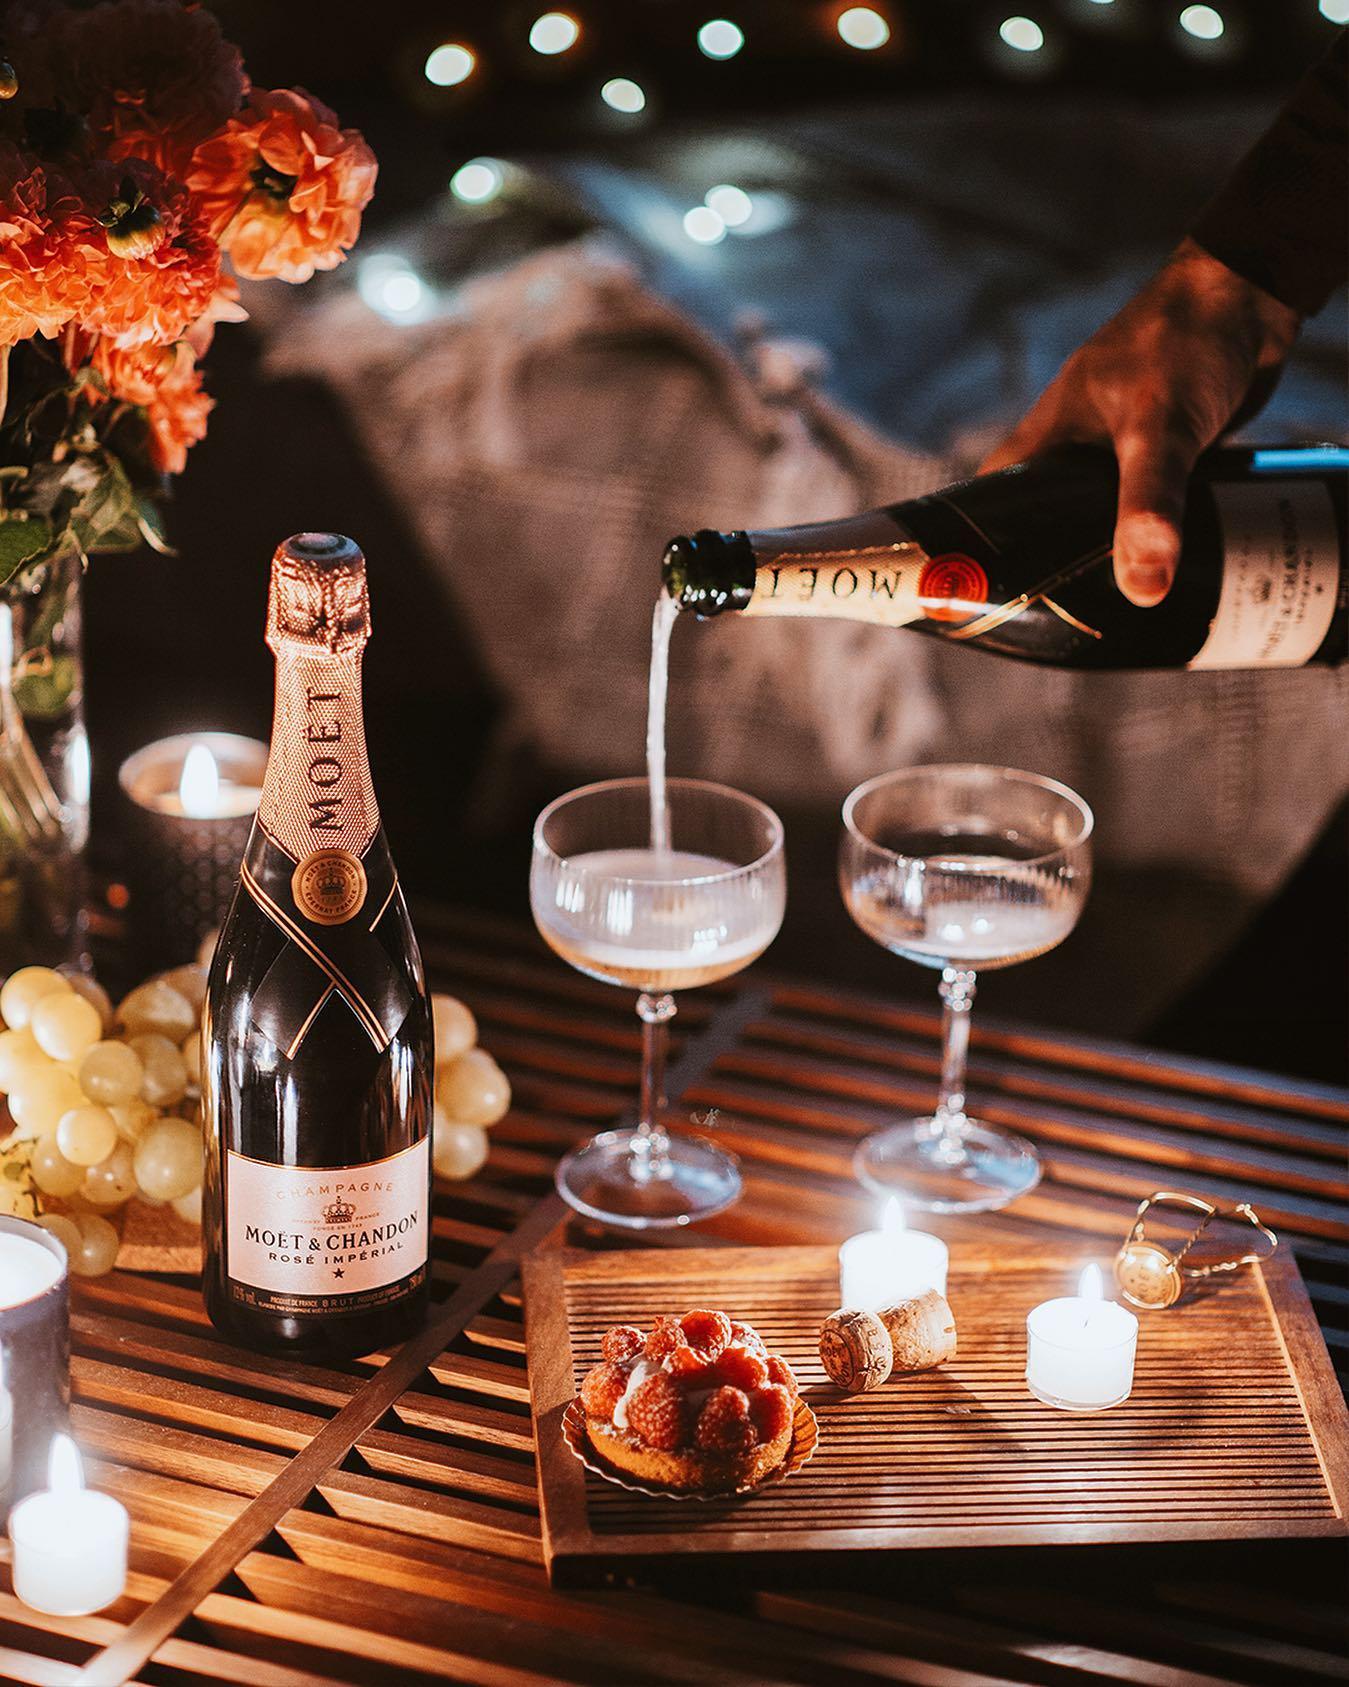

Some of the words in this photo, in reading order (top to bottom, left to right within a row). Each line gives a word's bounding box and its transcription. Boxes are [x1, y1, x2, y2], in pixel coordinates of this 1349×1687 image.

[276, 1182, 394, 1200] CHAMPAGNE
[245, 1224, 304, 1250] MOËT
[308, 1237, 321, 1251] &
[326, 1210, 419, 1250] CHANDON
[269, 1252, 315, 1265] ROSÉ
[325, 1242, 404, 1265] IMPÉRIAL
[322, 1298, 354, 1308] BRUT
